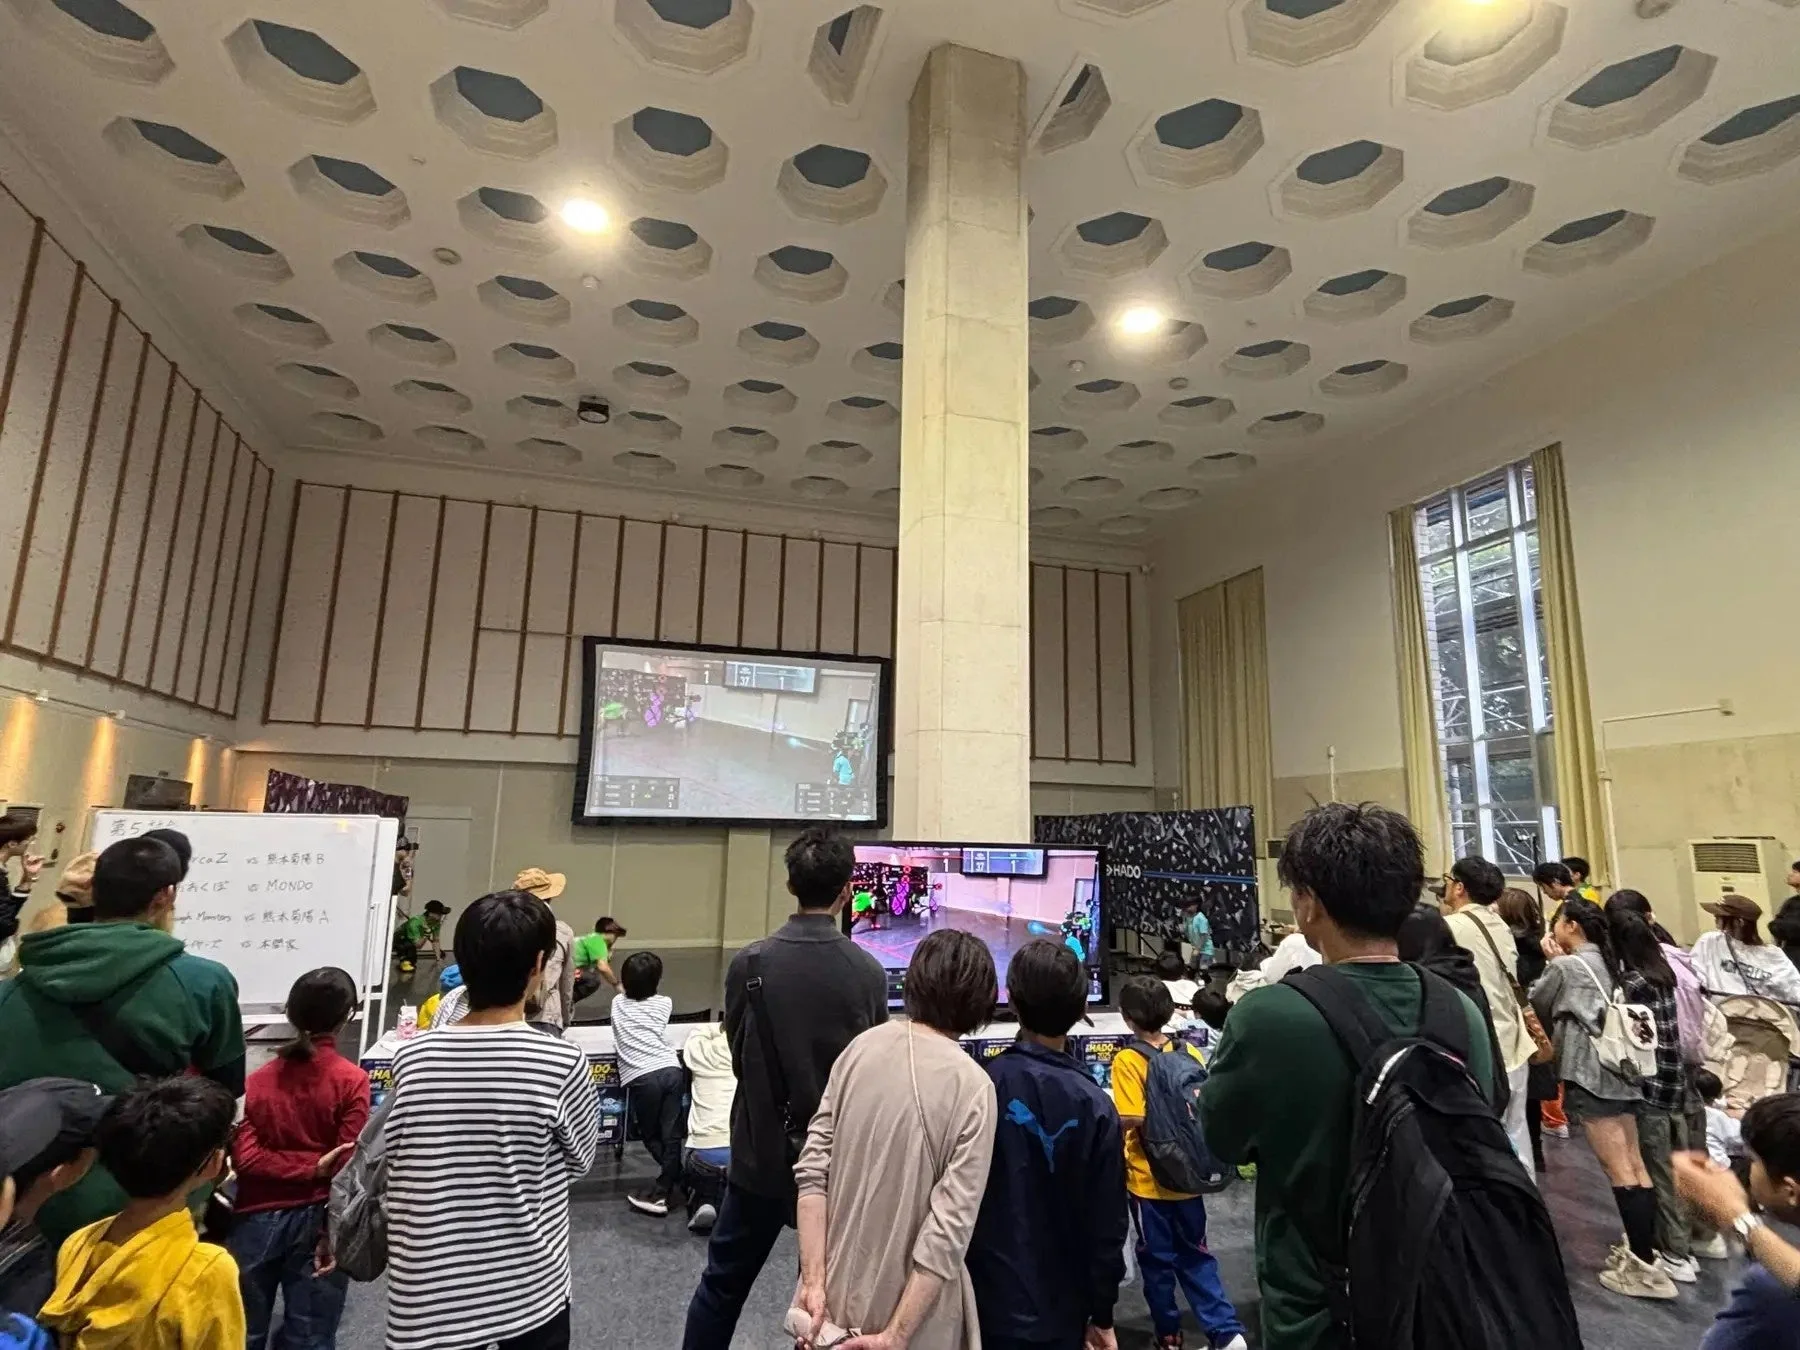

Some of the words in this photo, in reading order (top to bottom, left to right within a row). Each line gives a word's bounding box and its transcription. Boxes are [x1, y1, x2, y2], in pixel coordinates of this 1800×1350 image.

[739, 676, 750, 687] 37
[943, 858, 949, 872] 1
[975, 861, 985, 872] 37
[1113, 863, 1141, 879] HADO
[265, 878, 314, 892] MONDO
